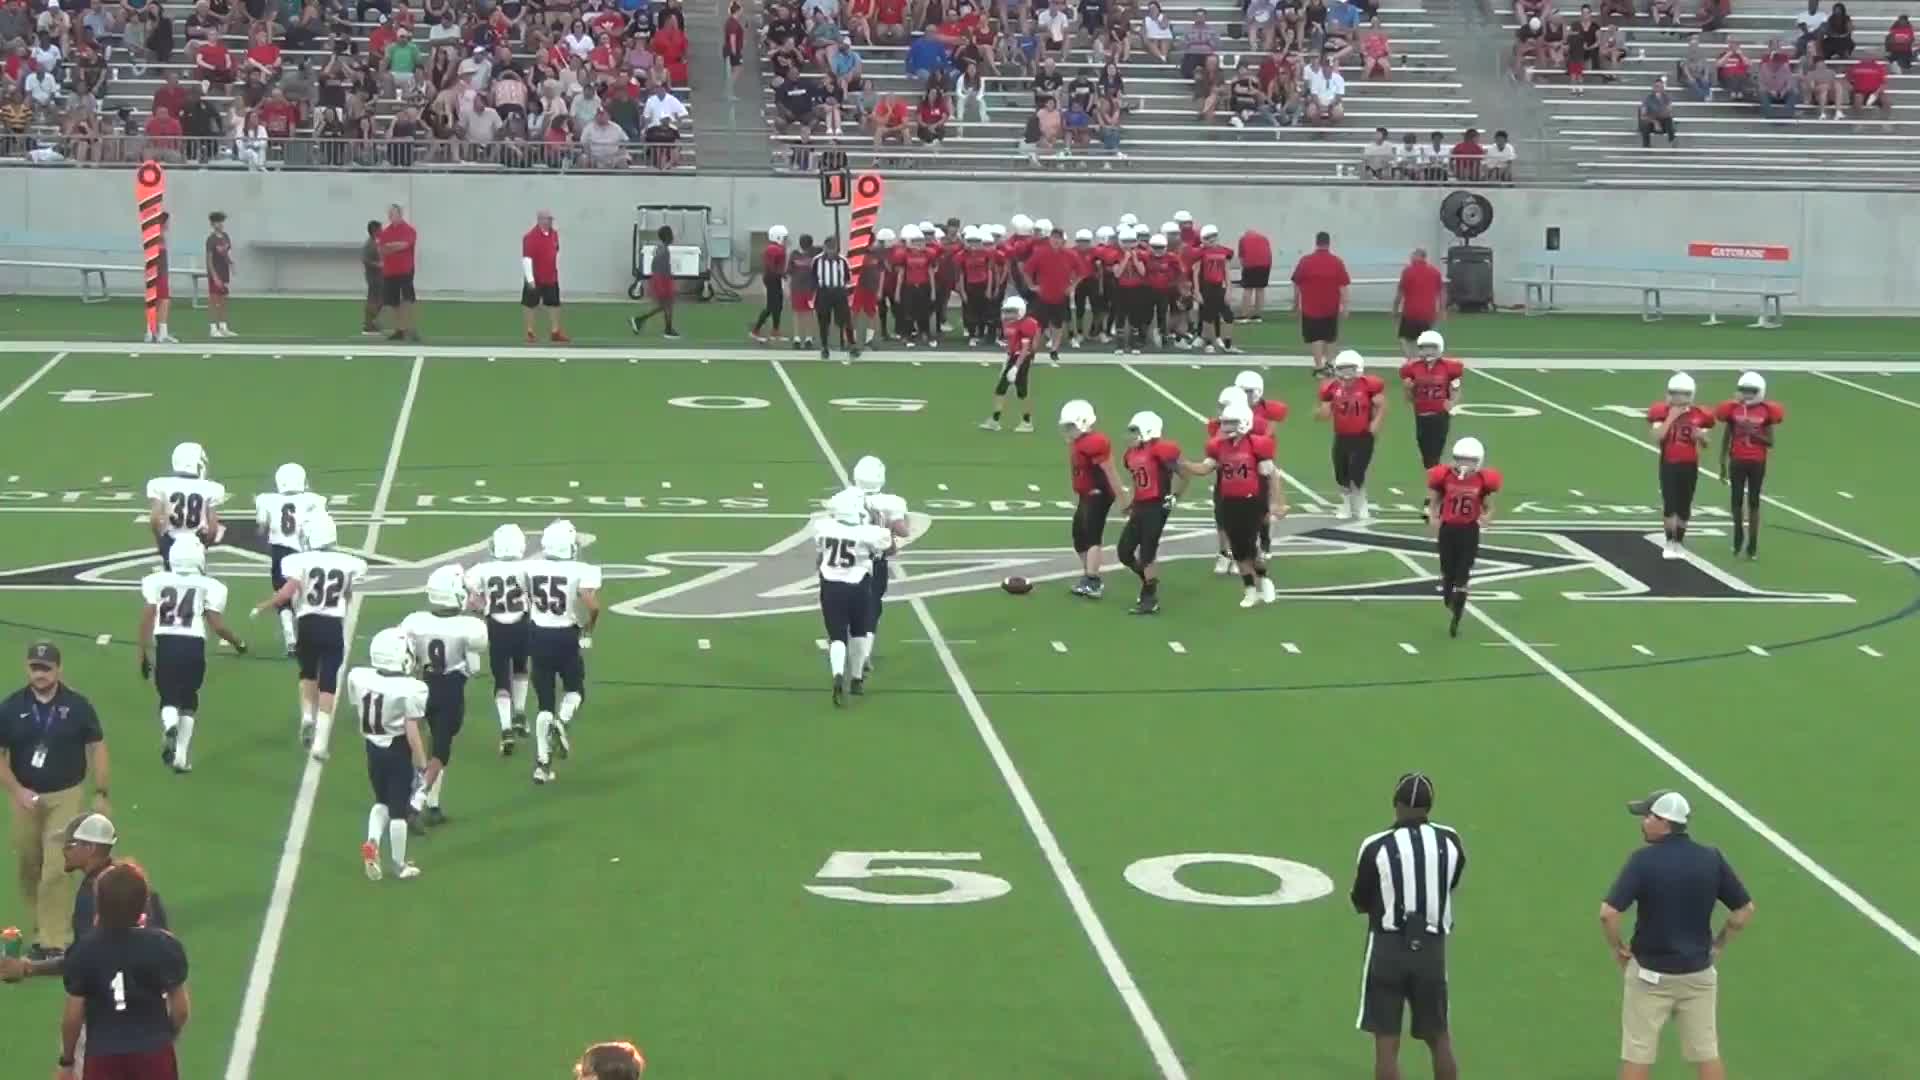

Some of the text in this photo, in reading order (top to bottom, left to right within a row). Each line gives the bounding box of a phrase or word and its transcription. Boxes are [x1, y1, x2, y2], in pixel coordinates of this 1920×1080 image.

[1711, 246, 1765, 259] GATORADE
[169, 491, 204, 529] 38
[280, 502, 297, 537] 6
[825, 537, 857, 568] 75
[307, 567, 345, 607] 32
[487, 575, 524, 614] 22
[531, 575, 568, 616] 55
[159, 586, 196, 628] 24
[426, 638, 446, 675] 9
[362, 691, 386, 735] 11
[802, 850, 1335, 906] 50
[110, 971, 127, 1011] 1
